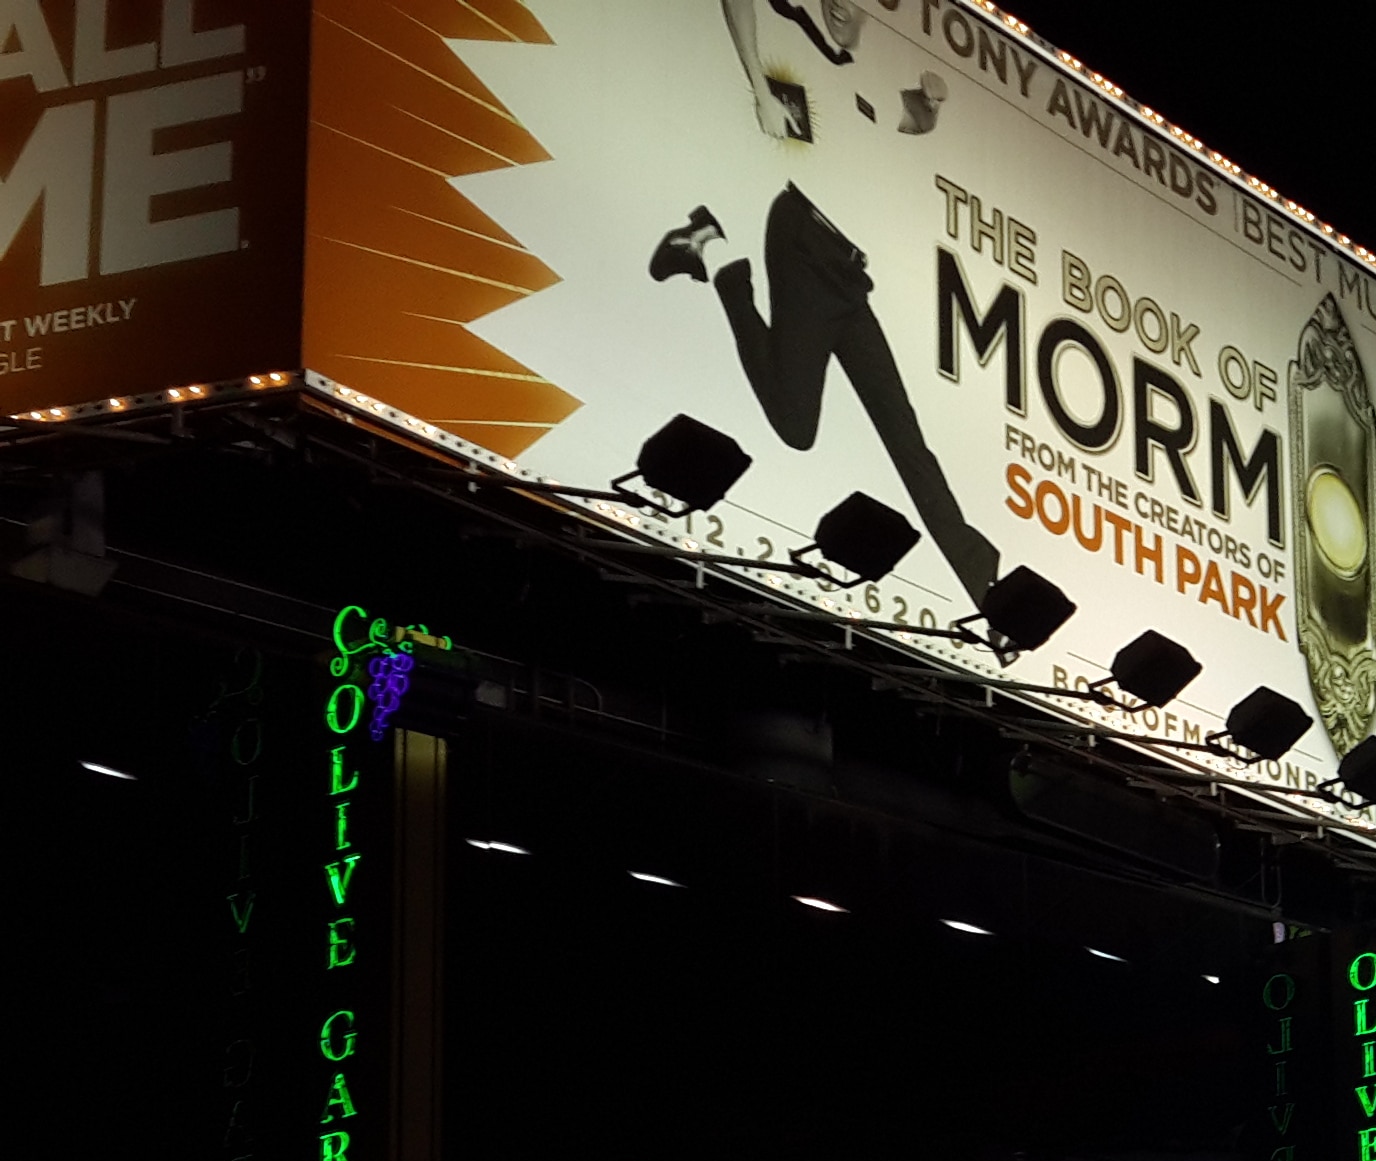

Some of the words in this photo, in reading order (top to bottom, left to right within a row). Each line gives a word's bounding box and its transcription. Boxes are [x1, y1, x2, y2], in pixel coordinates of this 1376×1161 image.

[920, 0, 1041, 98] TONY
[1046, 78, 1219, 216] AWARDS
[1242, 198, 1330, 285] BEST
[24, 298, 138, 338] WEEKLY
[935, 174, 1038, 286] THE
[1062, 248, 1202, 378] BOOK
[1219, 344, 1279, 411] OF
[1005, 423, 1077, 487] FROM
[1084, 461, 1129, 512] THE
[1135, 483, 1252, 569] CREATORS
[1256, 543, 1286, 585] OF
[1005, 460, 1167, 585] SOUTH
[1176, 528, 1288, 643] PARK
[323, 682, 366, 973] OLIVE
